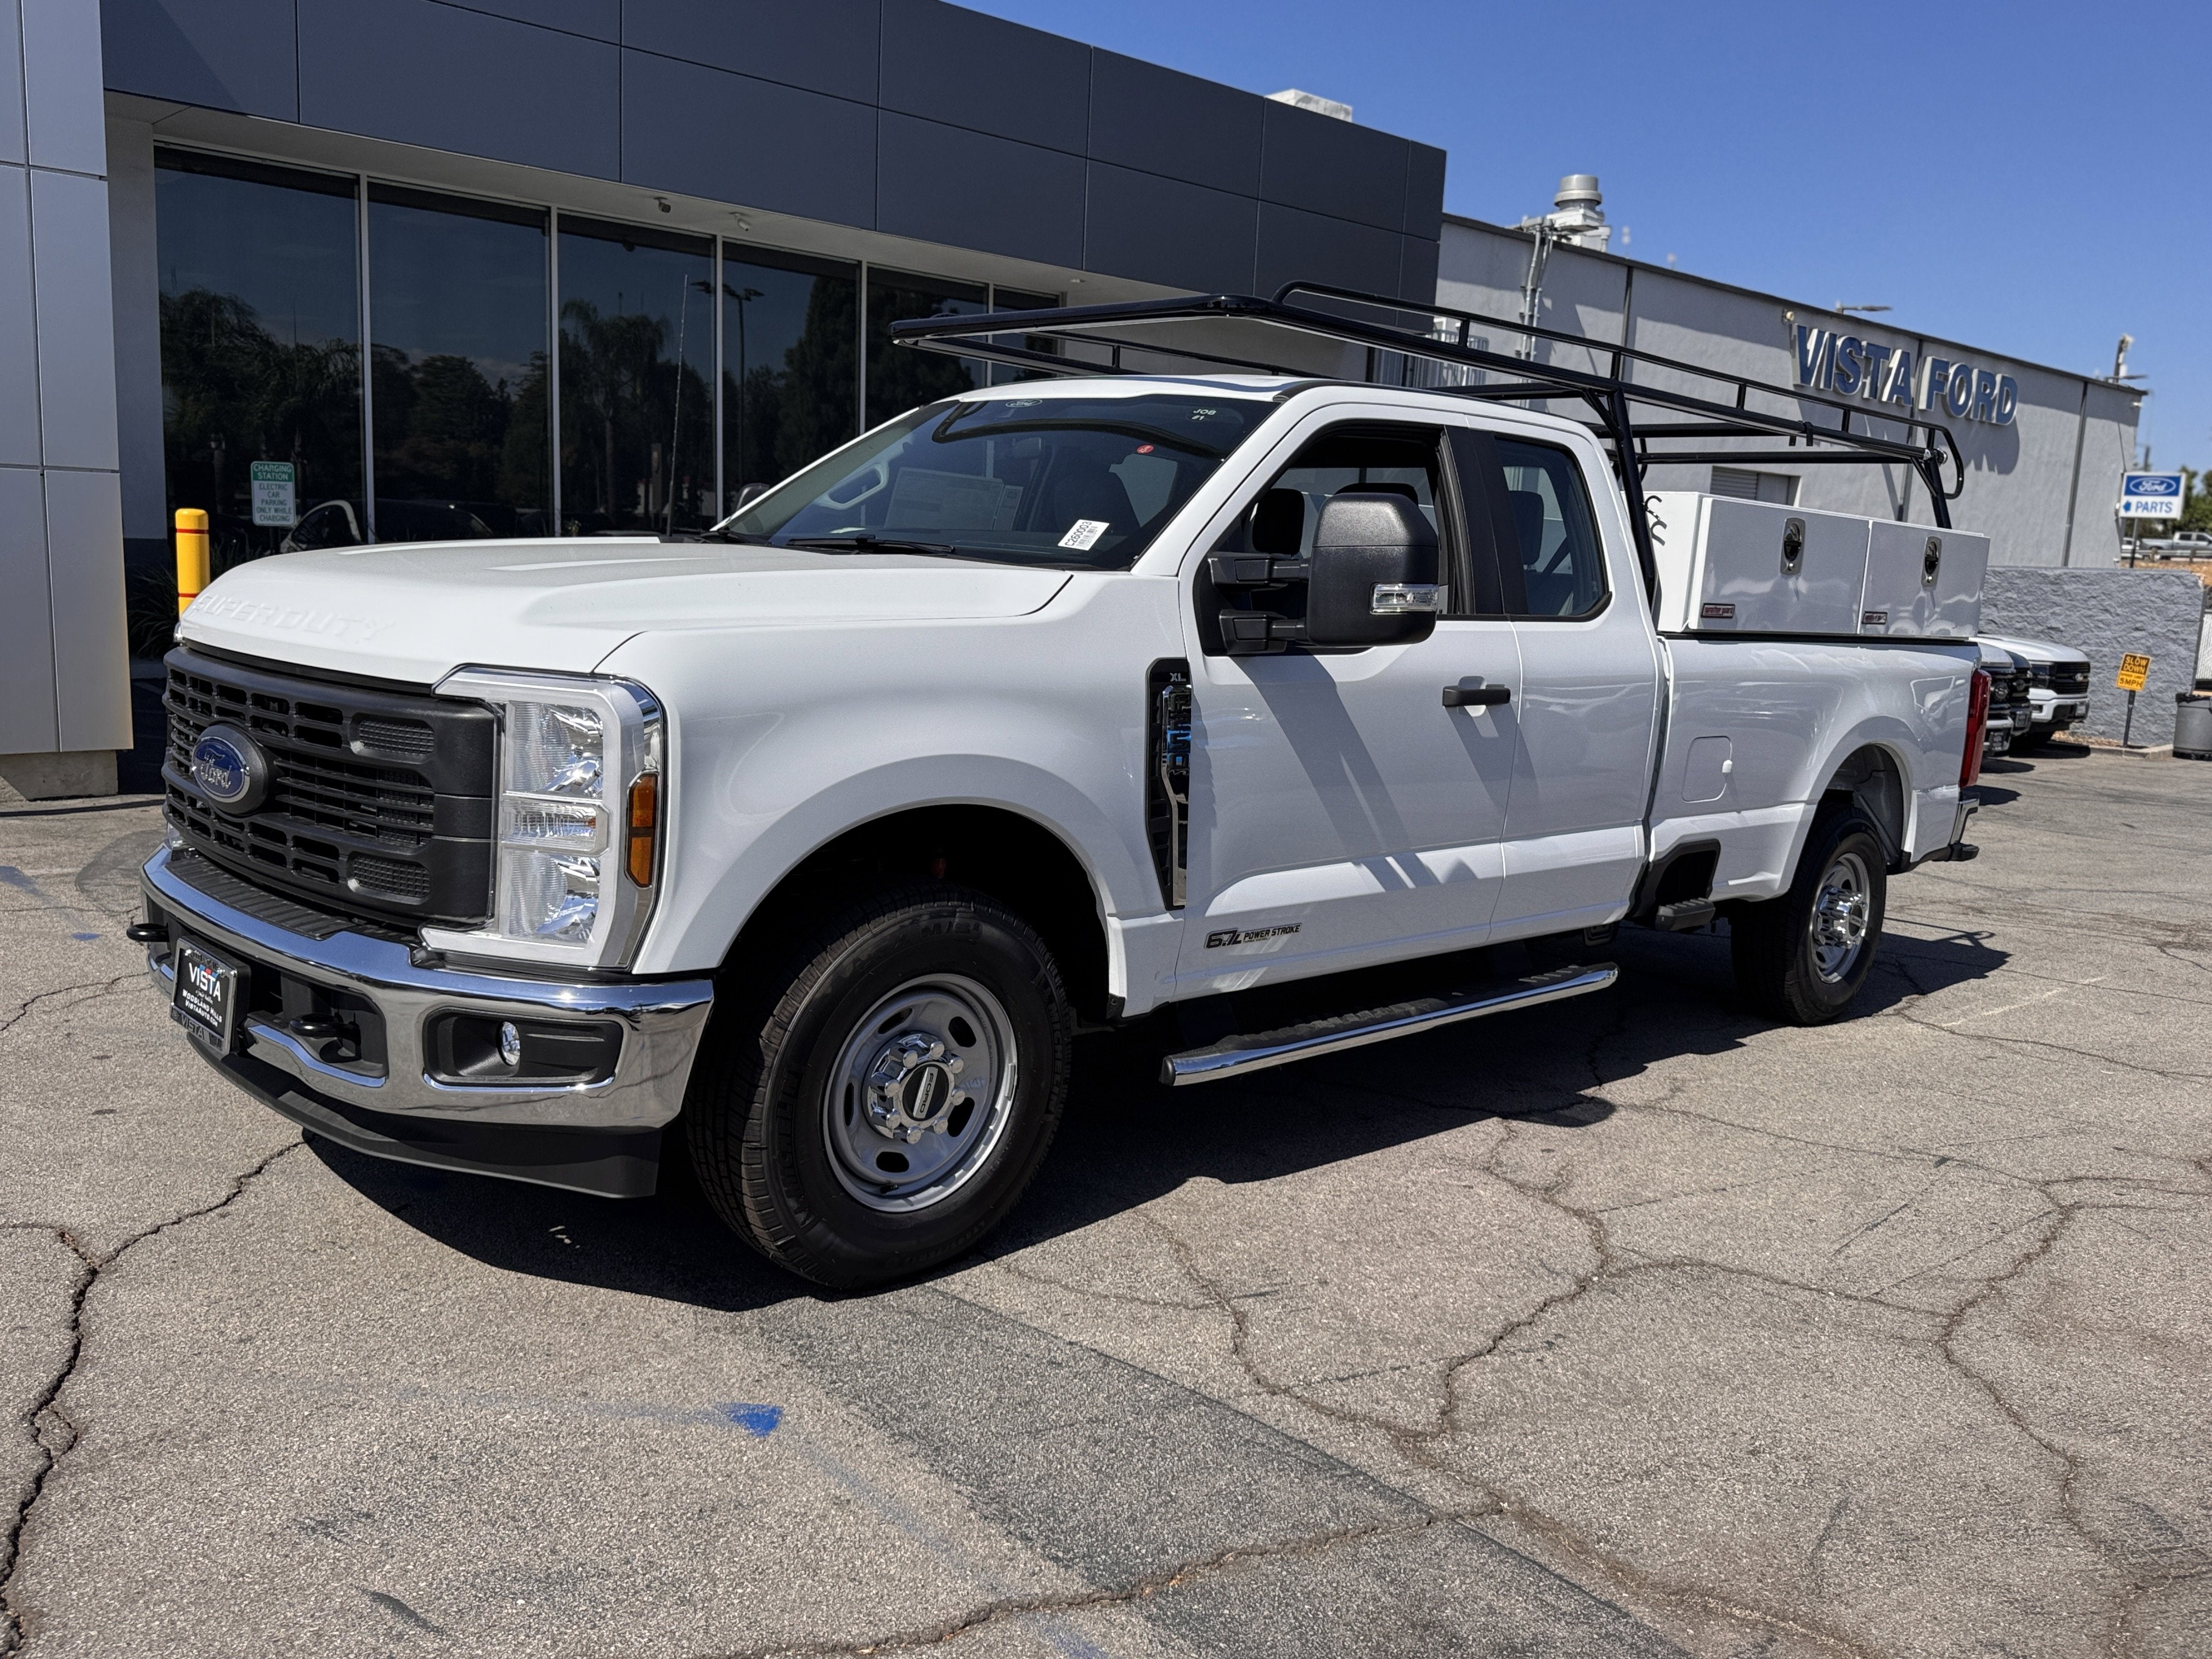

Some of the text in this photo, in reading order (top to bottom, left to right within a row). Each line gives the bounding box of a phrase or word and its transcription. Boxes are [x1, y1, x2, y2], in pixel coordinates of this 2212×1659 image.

[1793, 323, 2018, 426] VISTA FORD
[253, 464, 292, 473] CHARGING
[257, 472, 289, 480] STATION
[2139, 480, 2167, 491] Ford
[2135, 501, 2172, 513] PARTS
[1064, 521, 1092, 546] C260003
[2123, 663, 2146, 674] DOWN
[2125, 656, 2148, 666] SLOW
[1170, 673, 1186, 682] XL
[1206, 924, 1301, 949] 6.7L POWER STROKE
[189, 962, 221, 1002] VISTA
[183, 988, 210, 1012] WOODLAND
[210, 1007, 222, 1023] HILLS
[181, 1013, 205, 1041] VISTA
[919, 1072, 934, 1114] FORD
